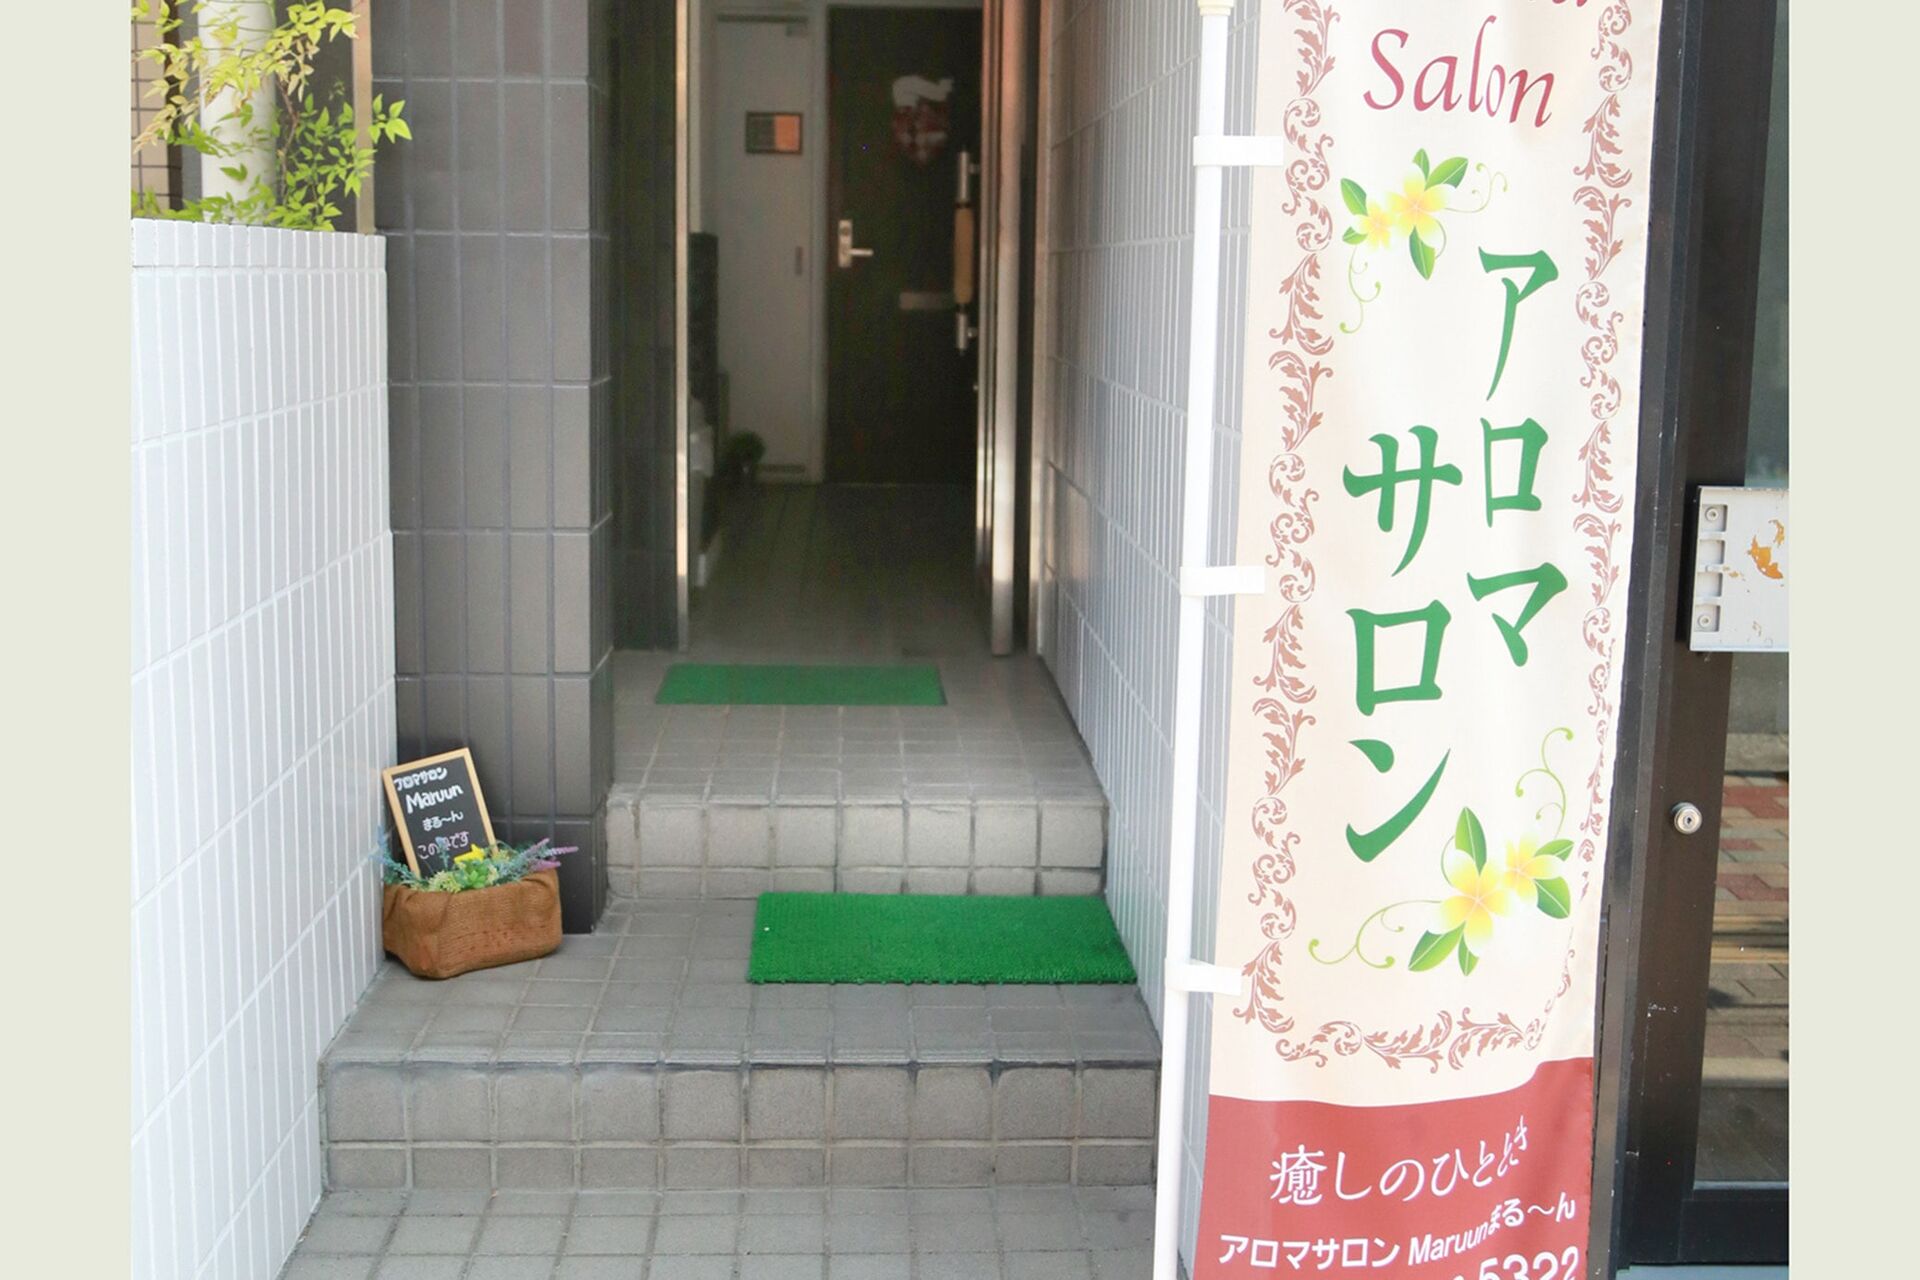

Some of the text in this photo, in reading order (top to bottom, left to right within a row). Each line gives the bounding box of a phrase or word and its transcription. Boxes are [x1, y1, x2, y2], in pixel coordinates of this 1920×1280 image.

[1363, 14, 1556, 128] Salon
[1466, 246, 1568, 668] アロマ
[1342, 424, 1463, 863] サロン
[406, 785, 464, 814] Maruun
[1269, 1115, 1529, 1205] 癒しのひととき
[1218, 1233, 1400, 1271] アロマサロン
